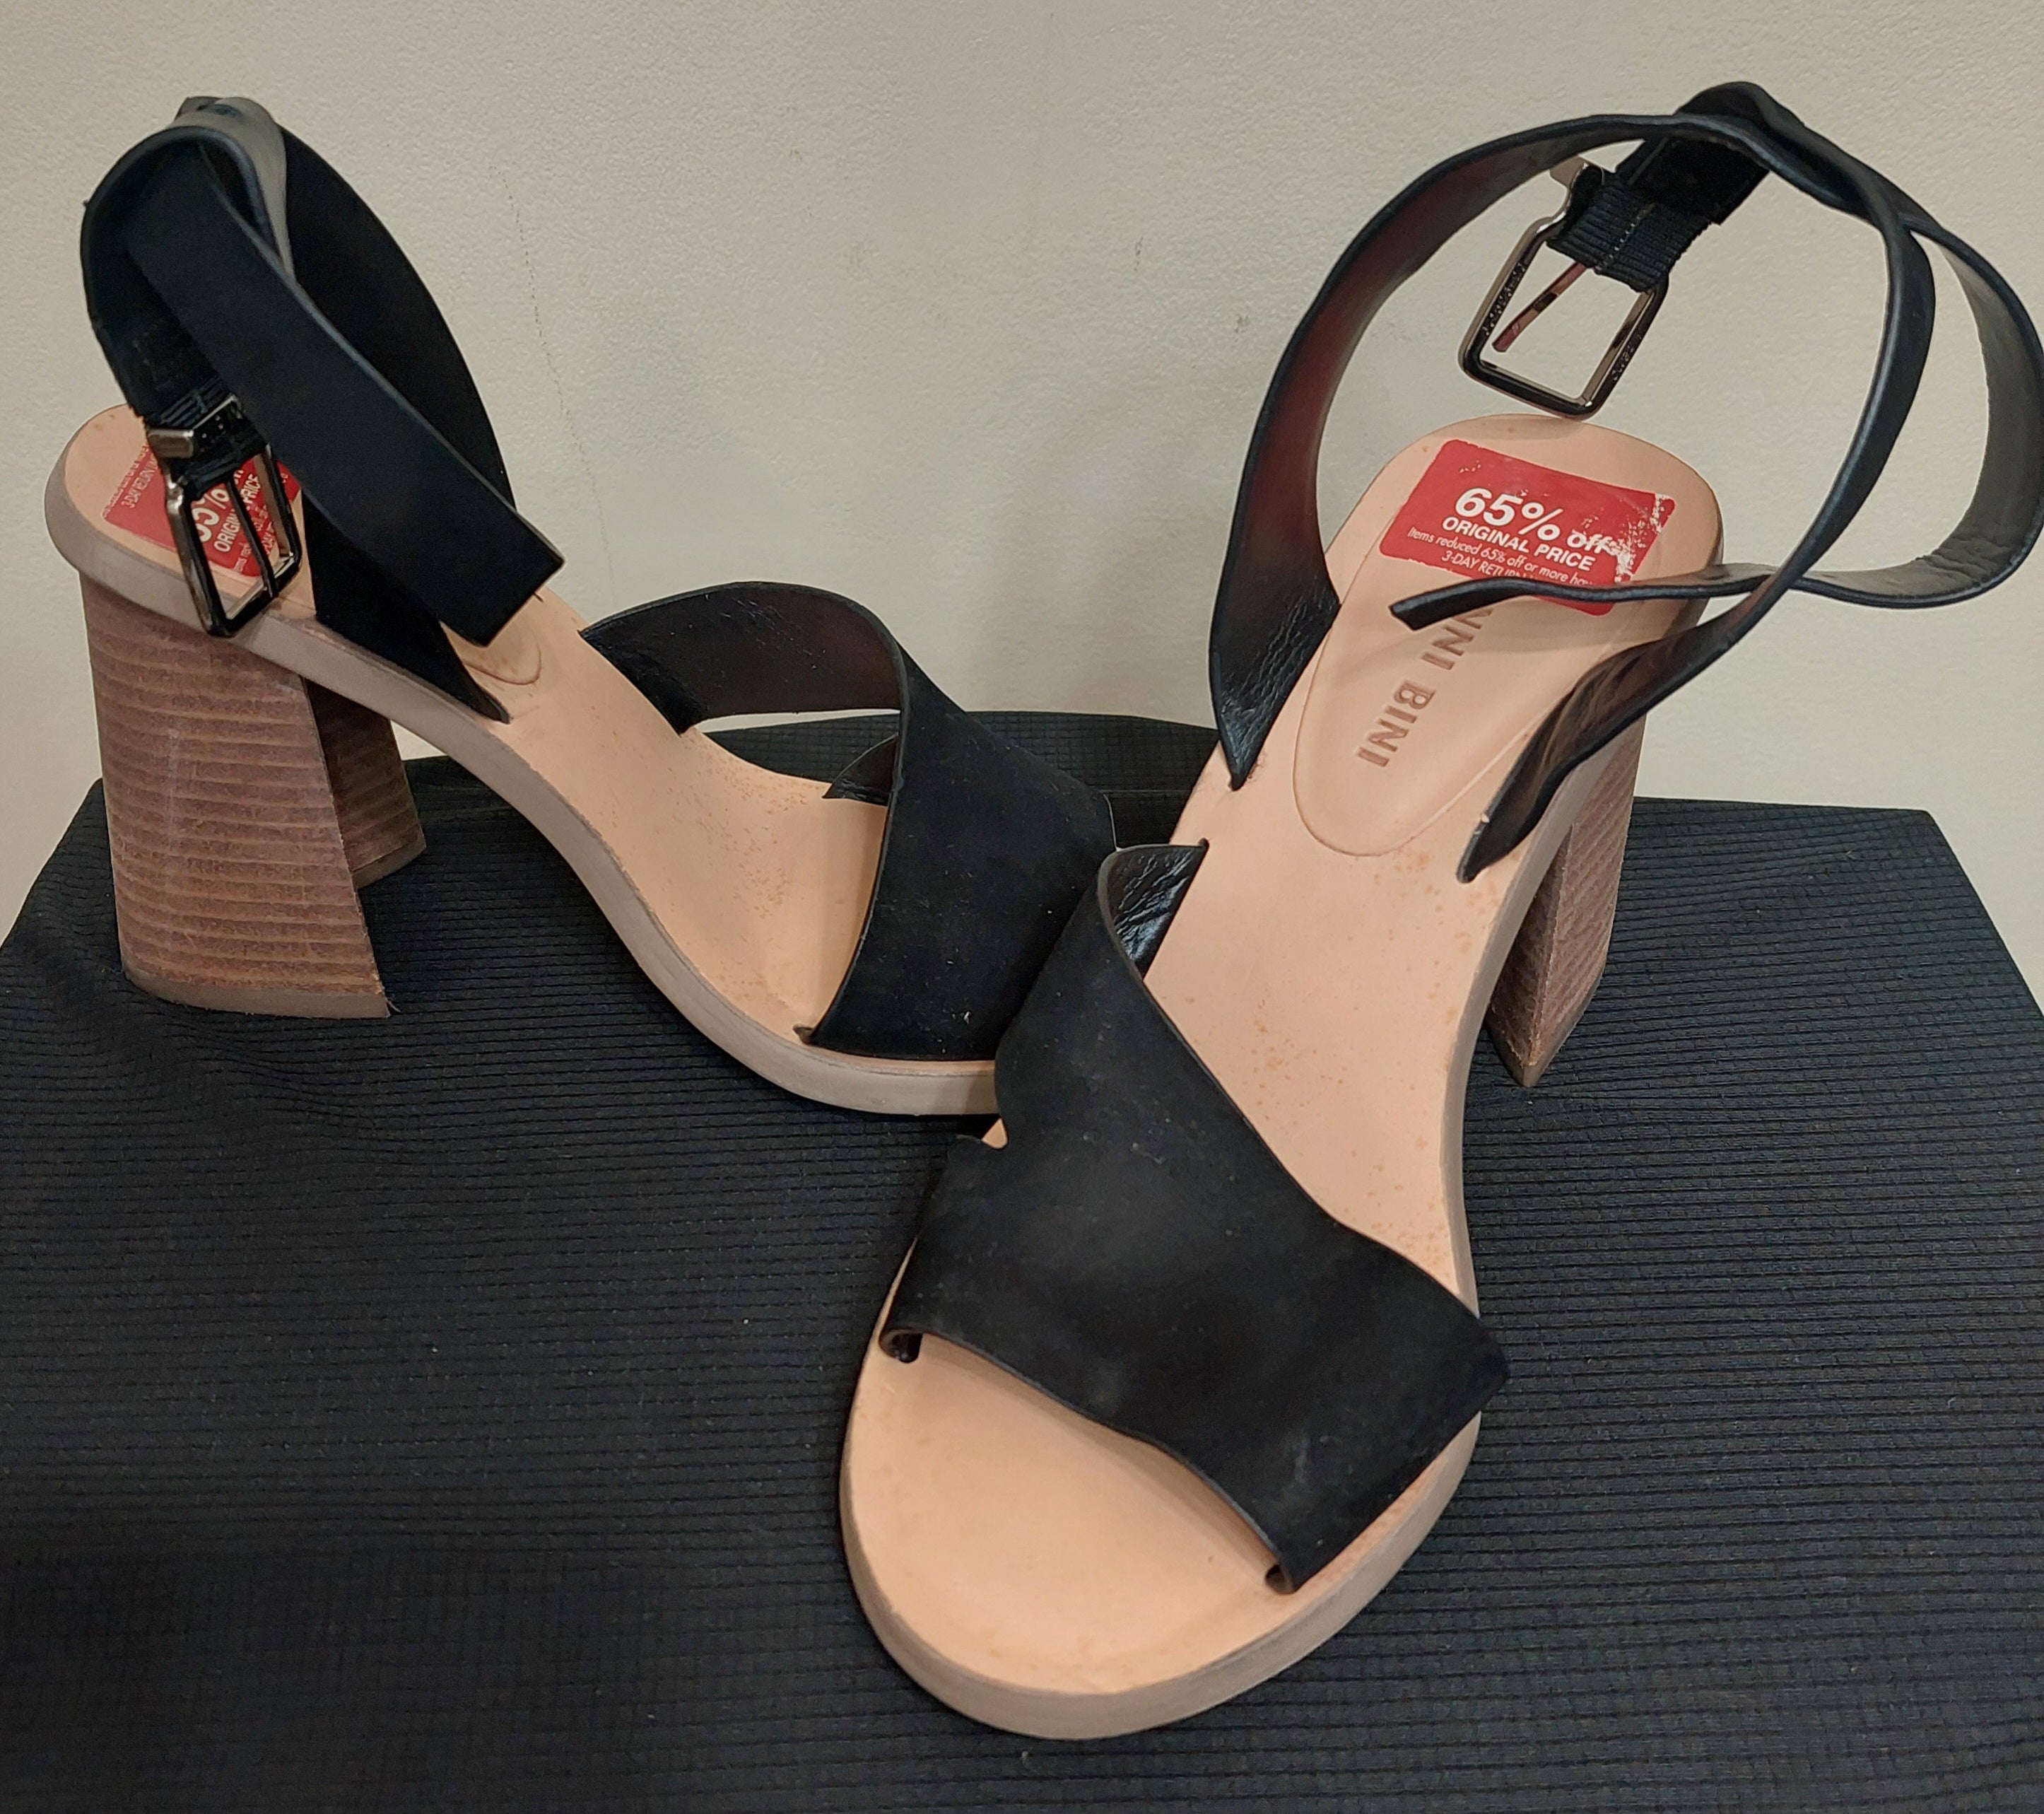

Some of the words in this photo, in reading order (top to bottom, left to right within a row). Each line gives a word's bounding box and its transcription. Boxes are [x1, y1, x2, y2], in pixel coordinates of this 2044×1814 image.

[1442, 516, 1529, 553] ORIGINAL
[1533, 544, 1597, 572] PRICE
[1455, 487, 1564, 542] 65%
[1567, 532, 1613, 554] off
[1407, 527, 1435, 544] Items
[1435, 536, 1483, 555] reduced
[1481, 547, 1506, 563] 65%
[1507, 554, 1528, 568] off
[1524, 562, 1539, 573] or
[1539, 567, 1569, 583] more
[1441, 551, 1481, 569] 3-DAY
[1357, 679, 1436, 768] BINI
